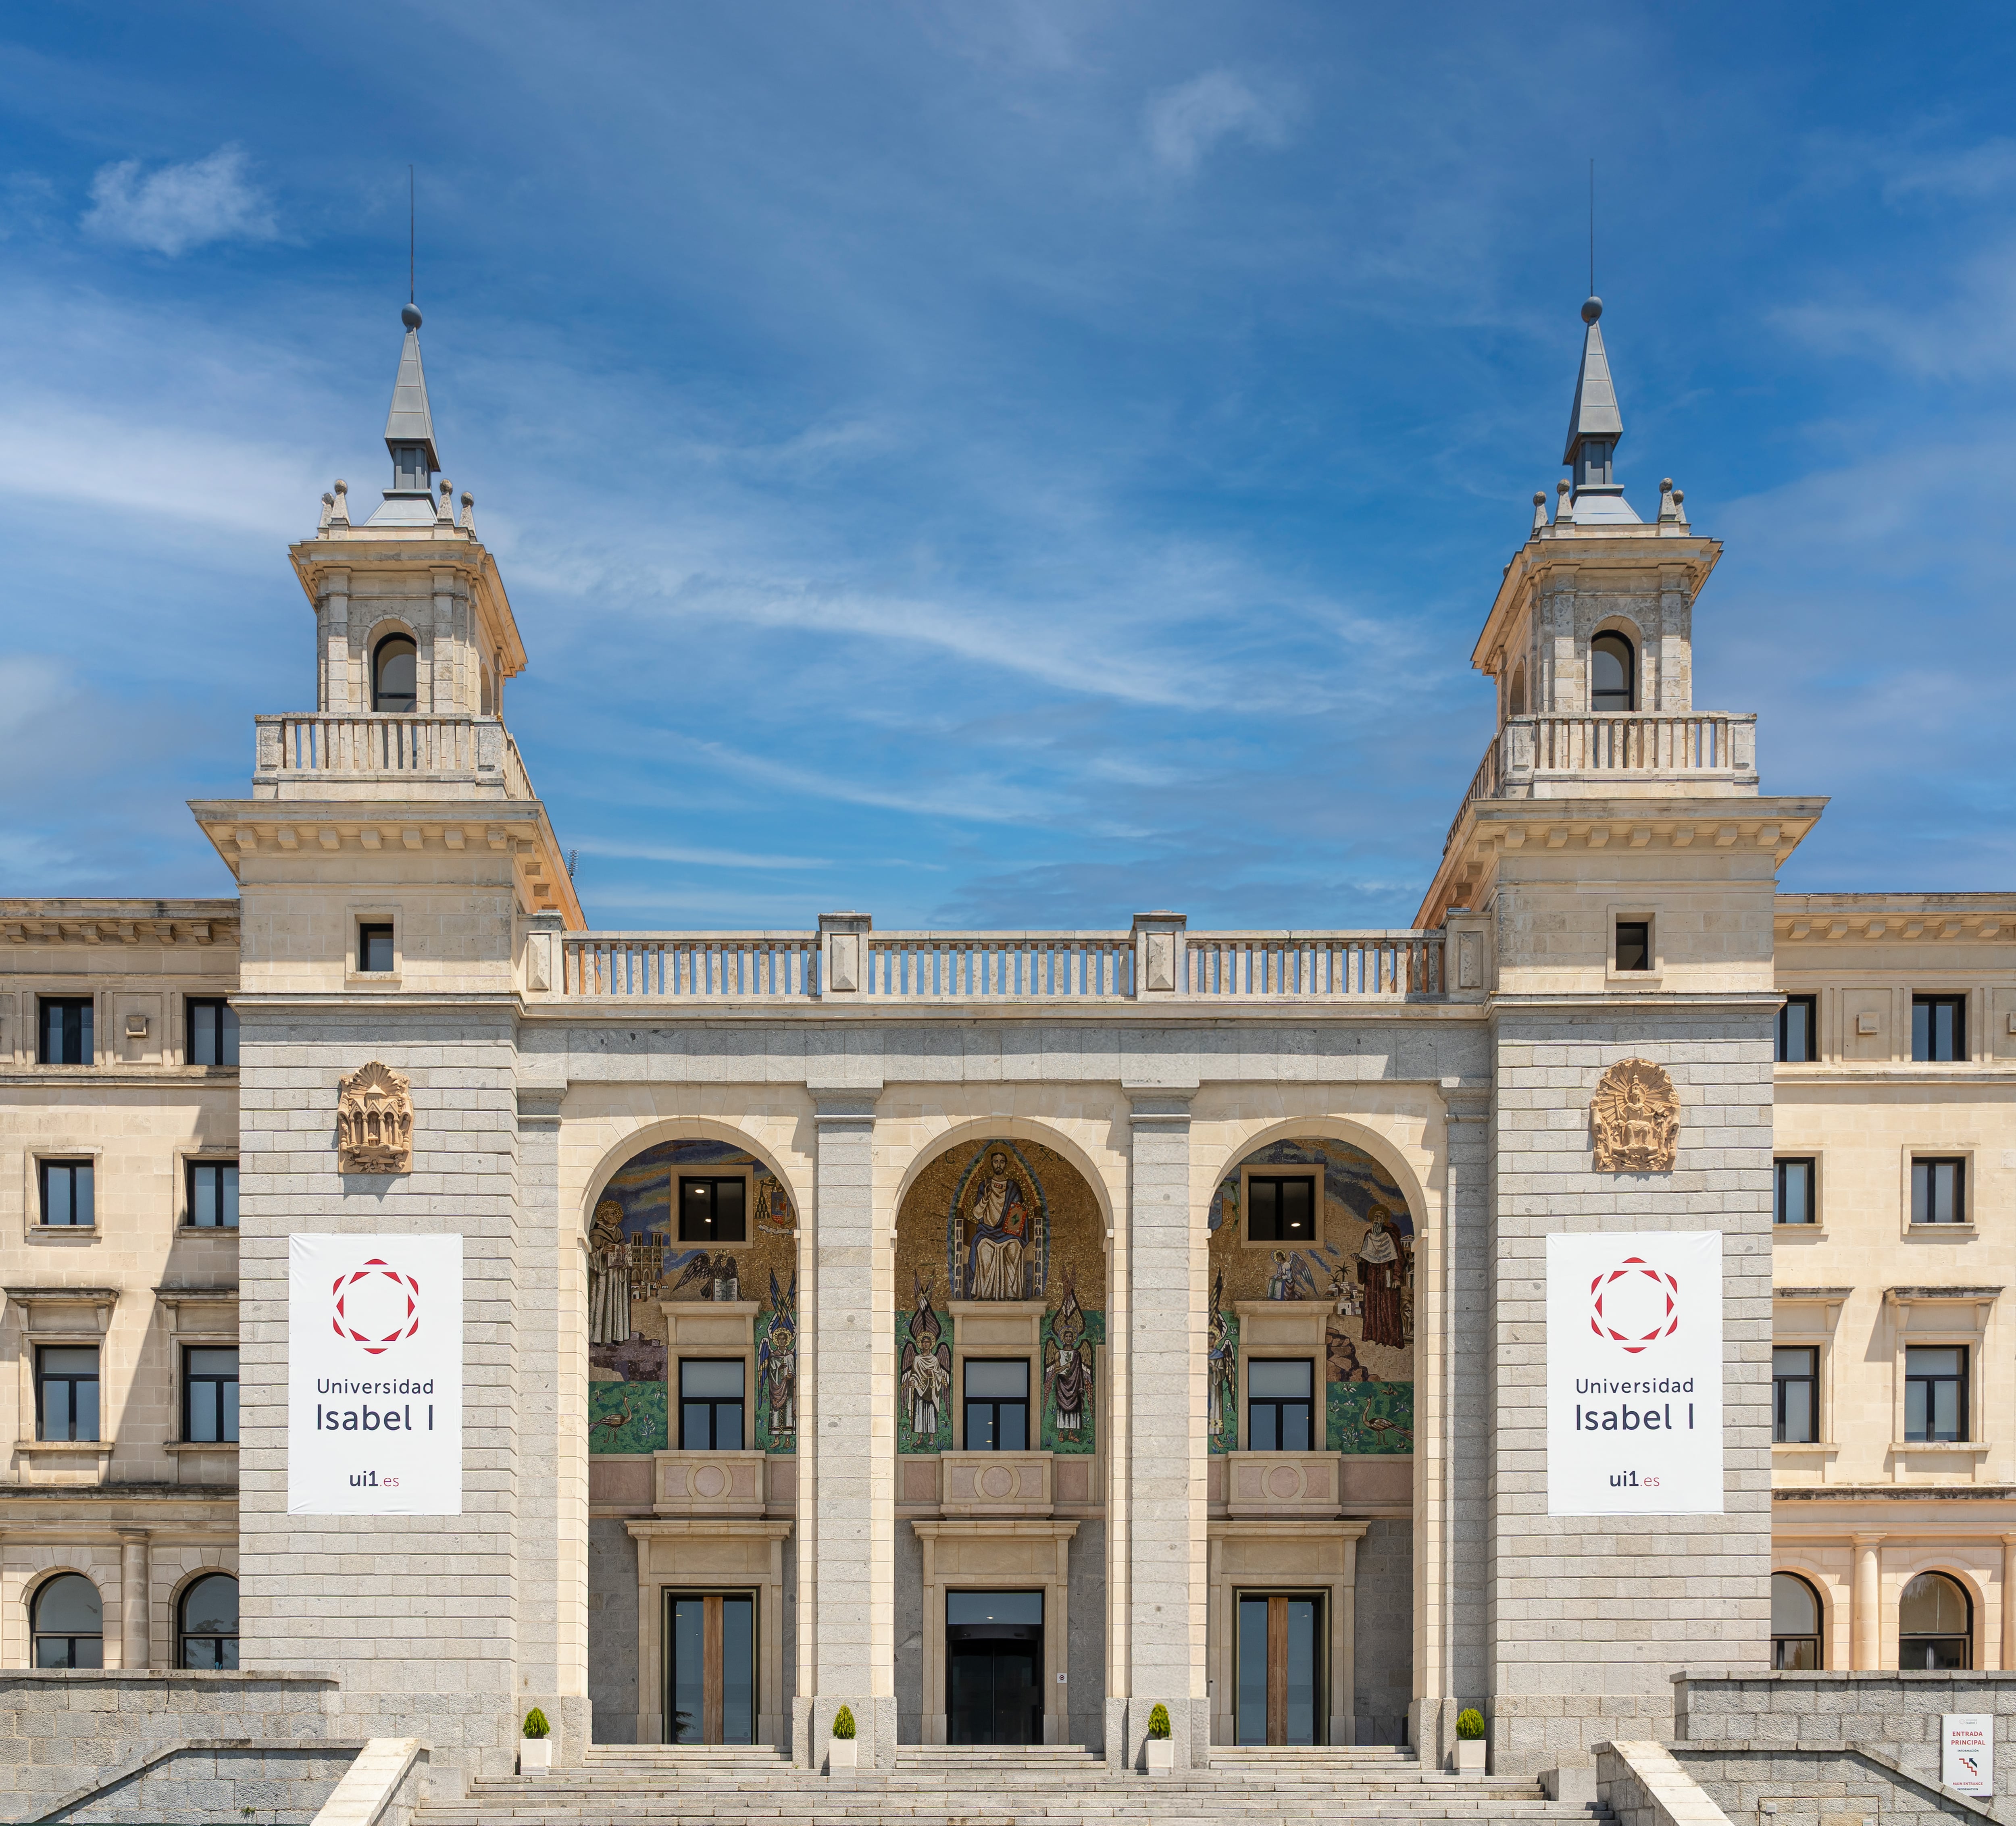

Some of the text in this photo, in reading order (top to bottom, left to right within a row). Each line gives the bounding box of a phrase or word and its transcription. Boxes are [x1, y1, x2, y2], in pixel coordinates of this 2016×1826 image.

[317, 1379, 433, 1394] Universidad
[1576, 1377, 1693, 1394] Universidad
[317, 1404, 433, 1431] Isabel I
[1576, 1403, 1693, 1431] Isabel I
[350, 1470, 399, 1487] ui1.es
[1610, 1470, 1660, 1487] ui1.es
